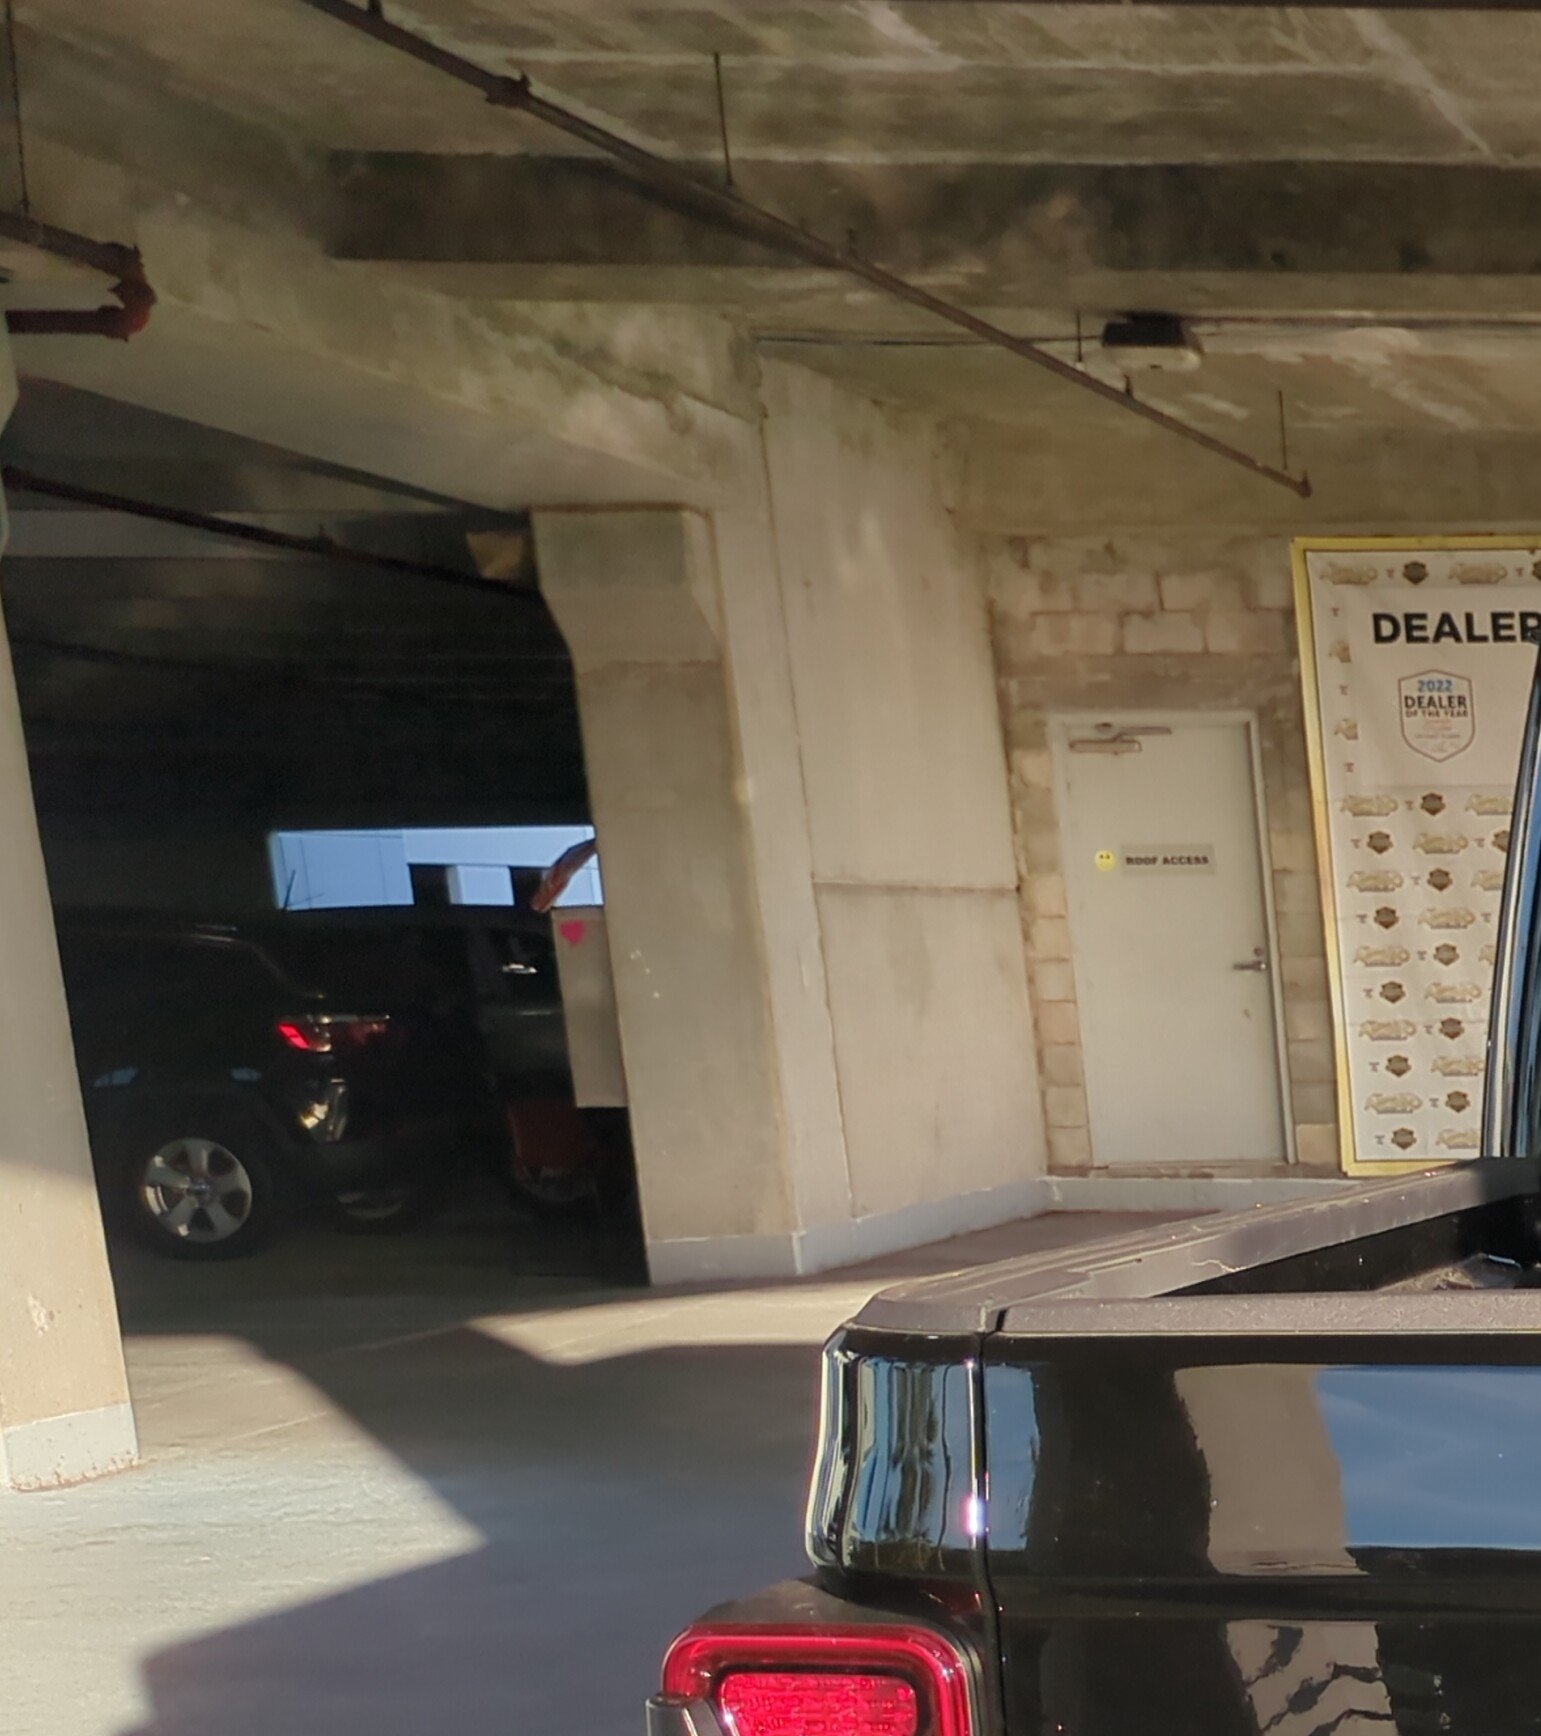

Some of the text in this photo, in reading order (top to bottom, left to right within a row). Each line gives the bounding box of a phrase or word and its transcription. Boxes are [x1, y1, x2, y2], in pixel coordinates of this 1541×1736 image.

[1417, 679, 1453, 693] 2022
[1404, 695, 1467, 709] DEALER
[1163, 855, 1209, 866] ACCESS
